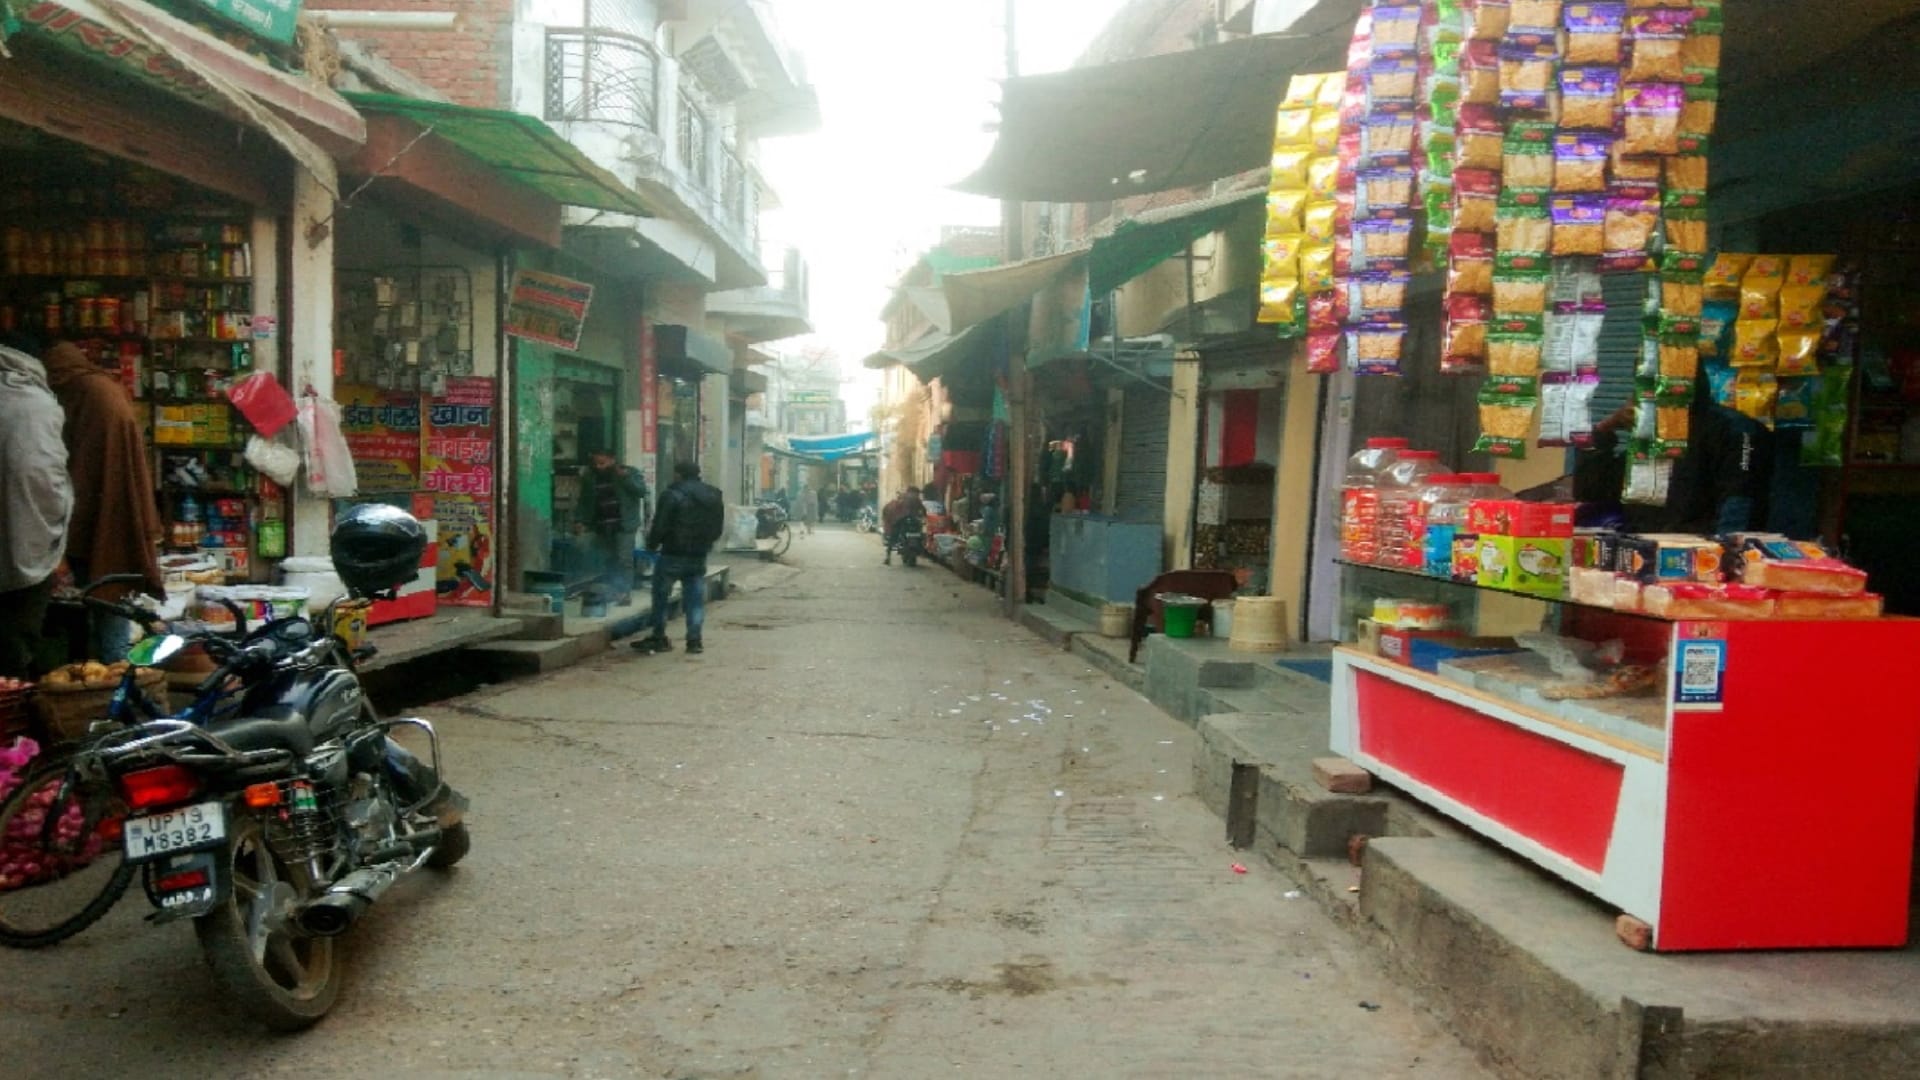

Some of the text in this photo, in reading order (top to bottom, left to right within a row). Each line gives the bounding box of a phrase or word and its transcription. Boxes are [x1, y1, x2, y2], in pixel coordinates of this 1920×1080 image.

[428, 404, 491, 426] खान
[421, 465, 491, 496] गैलरी
[143, 823, 211, 853] M8382
